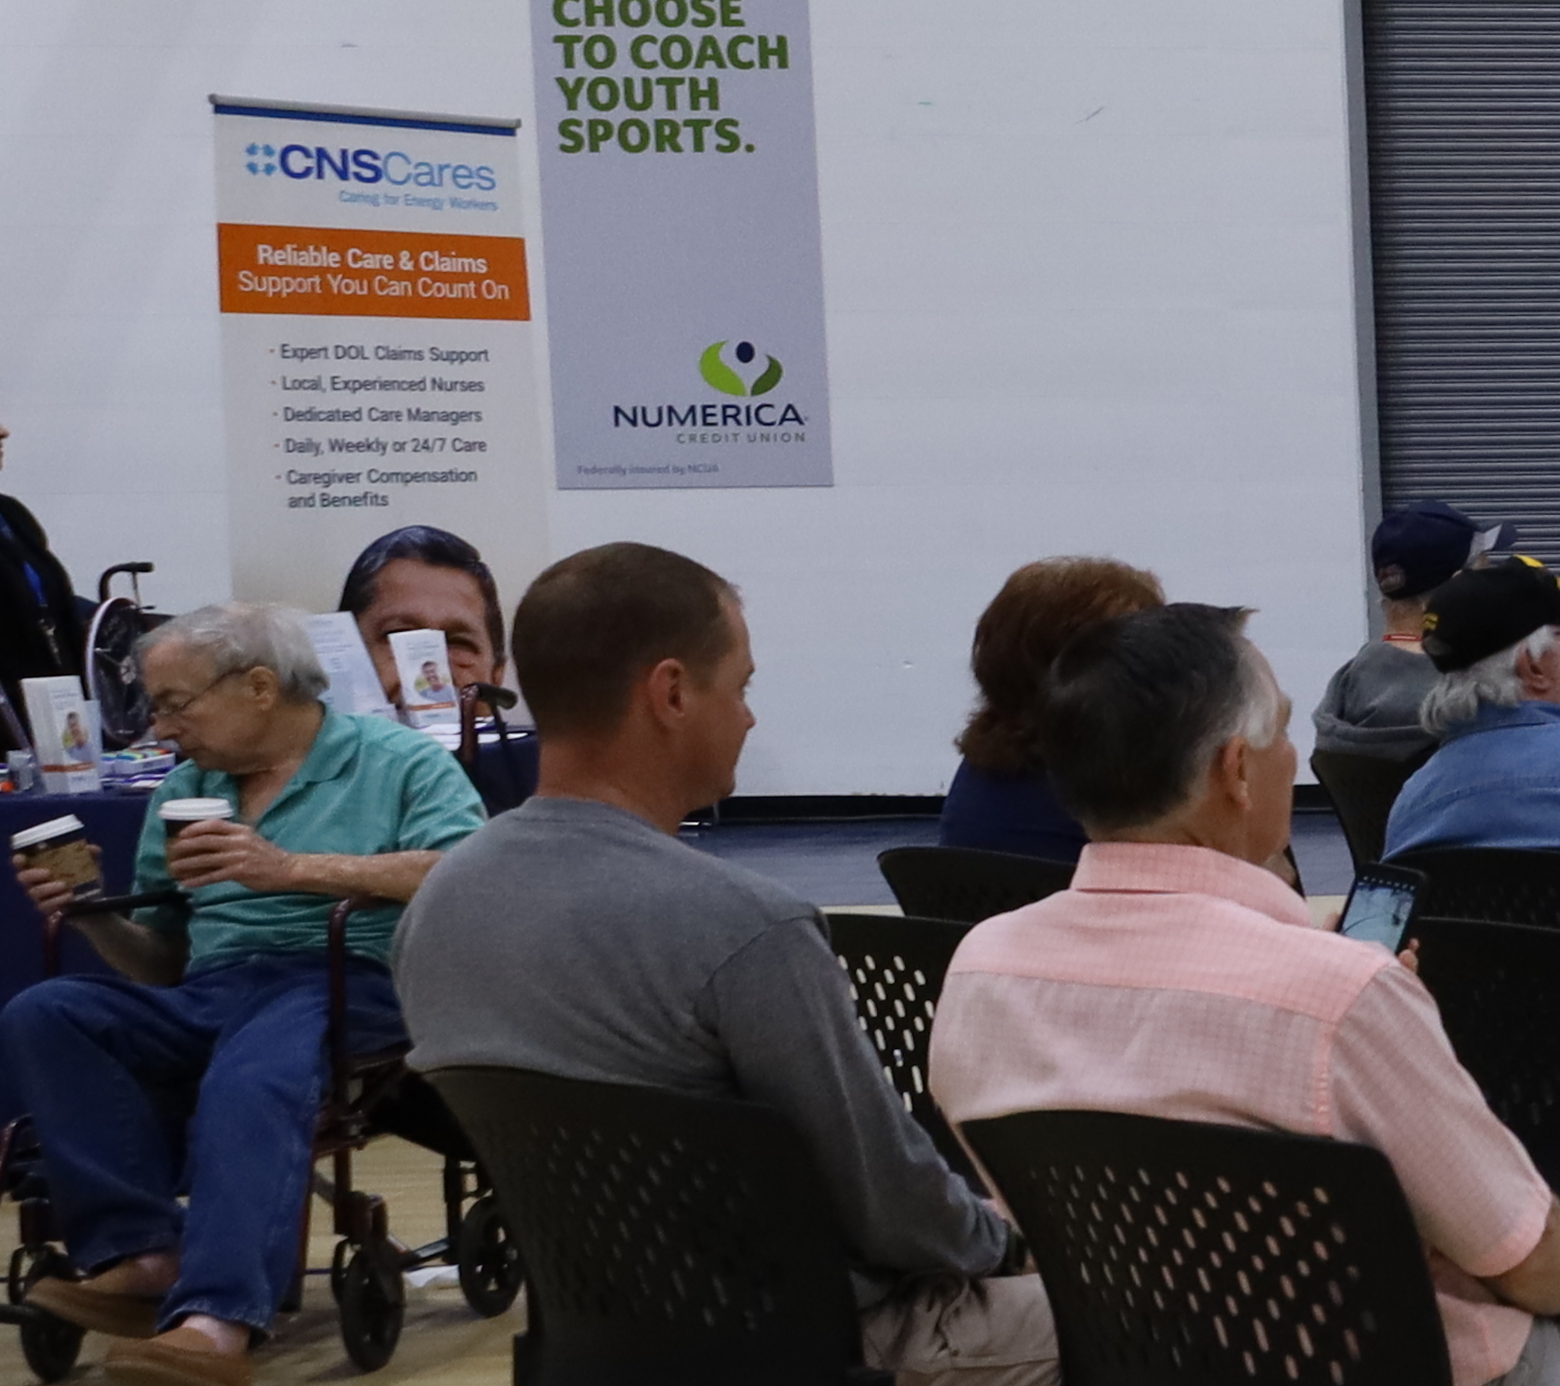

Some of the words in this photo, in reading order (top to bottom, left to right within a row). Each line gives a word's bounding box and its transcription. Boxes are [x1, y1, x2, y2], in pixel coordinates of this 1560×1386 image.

[553, 34, 617, 70] TO
[630, 34, 789, 70] COACH
[554, 76, 720, 112] YOUTH
[557, 117, 756, 154] SPORTS.
[278, 143, 497, 192] CNSCares
[257, 243, 341, 268] Reliable
[346, 247, 395, 270] Care
[400, 250, 414, 271] &
[419, 250, 488, 274] Claims
[237, 269, 322, 298] Support
[326, 273, 370, 296] You
[374, 275, 412, 297] Can
[417, 277, 476, 299] Count
[481, 279, 510, 300] On
[280, 344, 330, 363] Expert
[334, 345, 369, 361] DOL
[374, 345, 425, 362] Claims
[429, 346, 490, 365] Support
[281, 376, 327, 393] Local,
[330, 376, 427, 394] Experienced
[431, 377, 486, 393] Nurses
[283, 407, 362, 423] Dedicated
[367, 407, 403, 423] Care
[407, 407, 483, 426] Managers
[613, 403, 806, 428] NUMERICA
[284, 438, 324, 457] Daily,
[328, 437, 388, 456] Weekly
[392, 441, 408, 454] or
[410, 437, 447, 454] 24/7
[451, 437, 487, 453] Care
[676, 432, 740, 445] CREDIT
[748, 431, 806, 444] UNION
[287, 468, 361, 488] Caregiver
[367, 467, 478, 487] Compensation
[288, 492, 315, 509] and
[320, 491, 389, 508] Benefits
